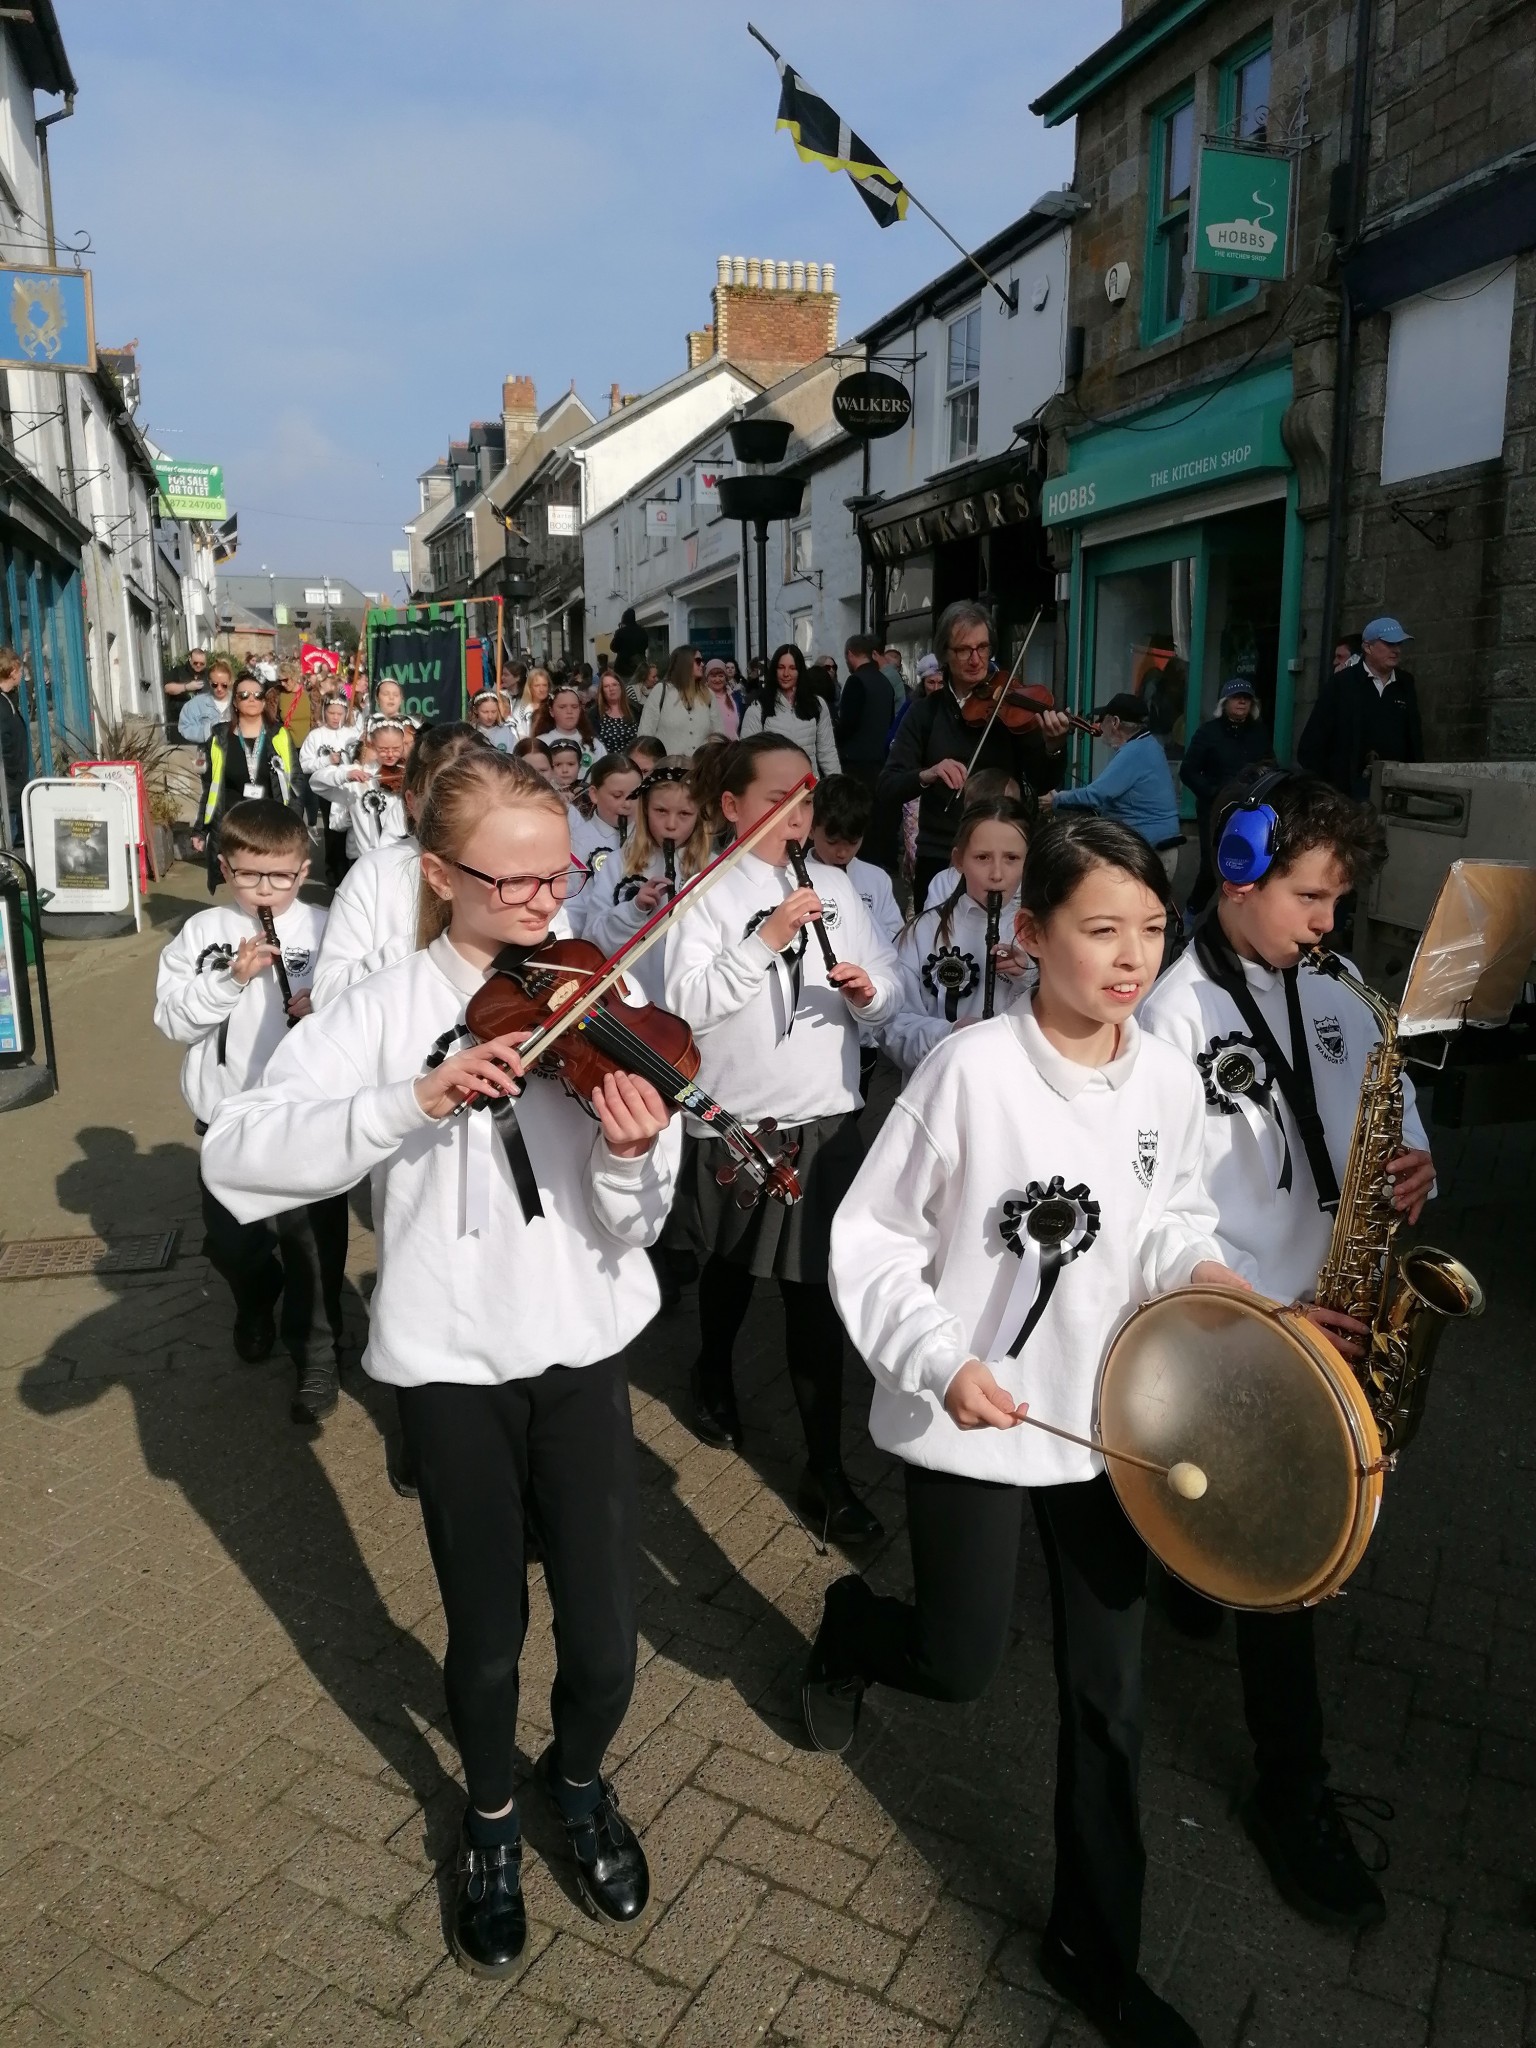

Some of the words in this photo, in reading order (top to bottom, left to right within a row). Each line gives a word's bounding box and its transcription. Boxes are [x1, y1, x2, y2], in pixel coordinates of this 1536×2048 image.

[1218, 230, 1264, 248] HOBBS
[1226, 251, 1250, 260] KITCHEN
[1251, 254, 1267, 262] SHOP
[836, 396, 910, 413] WALKERS
[168, 475, 186, 486] FOR
[187, 476, 209, 487] SALE
[1048, 482, 1096, 517] HOBBS
[1150, 469, 1169, 488] THE
[1172, 455, 1217, 482] KITCHEN
[1221, 445, 1251, 468] SHOP
[169, 484, 181, 494] OR
[182, 485, 194, 495] TO
[195, 486, 209, 496] LET
[189, 500, 222, 510] 247000
[871, 483, 1030, 558] WALKERS
